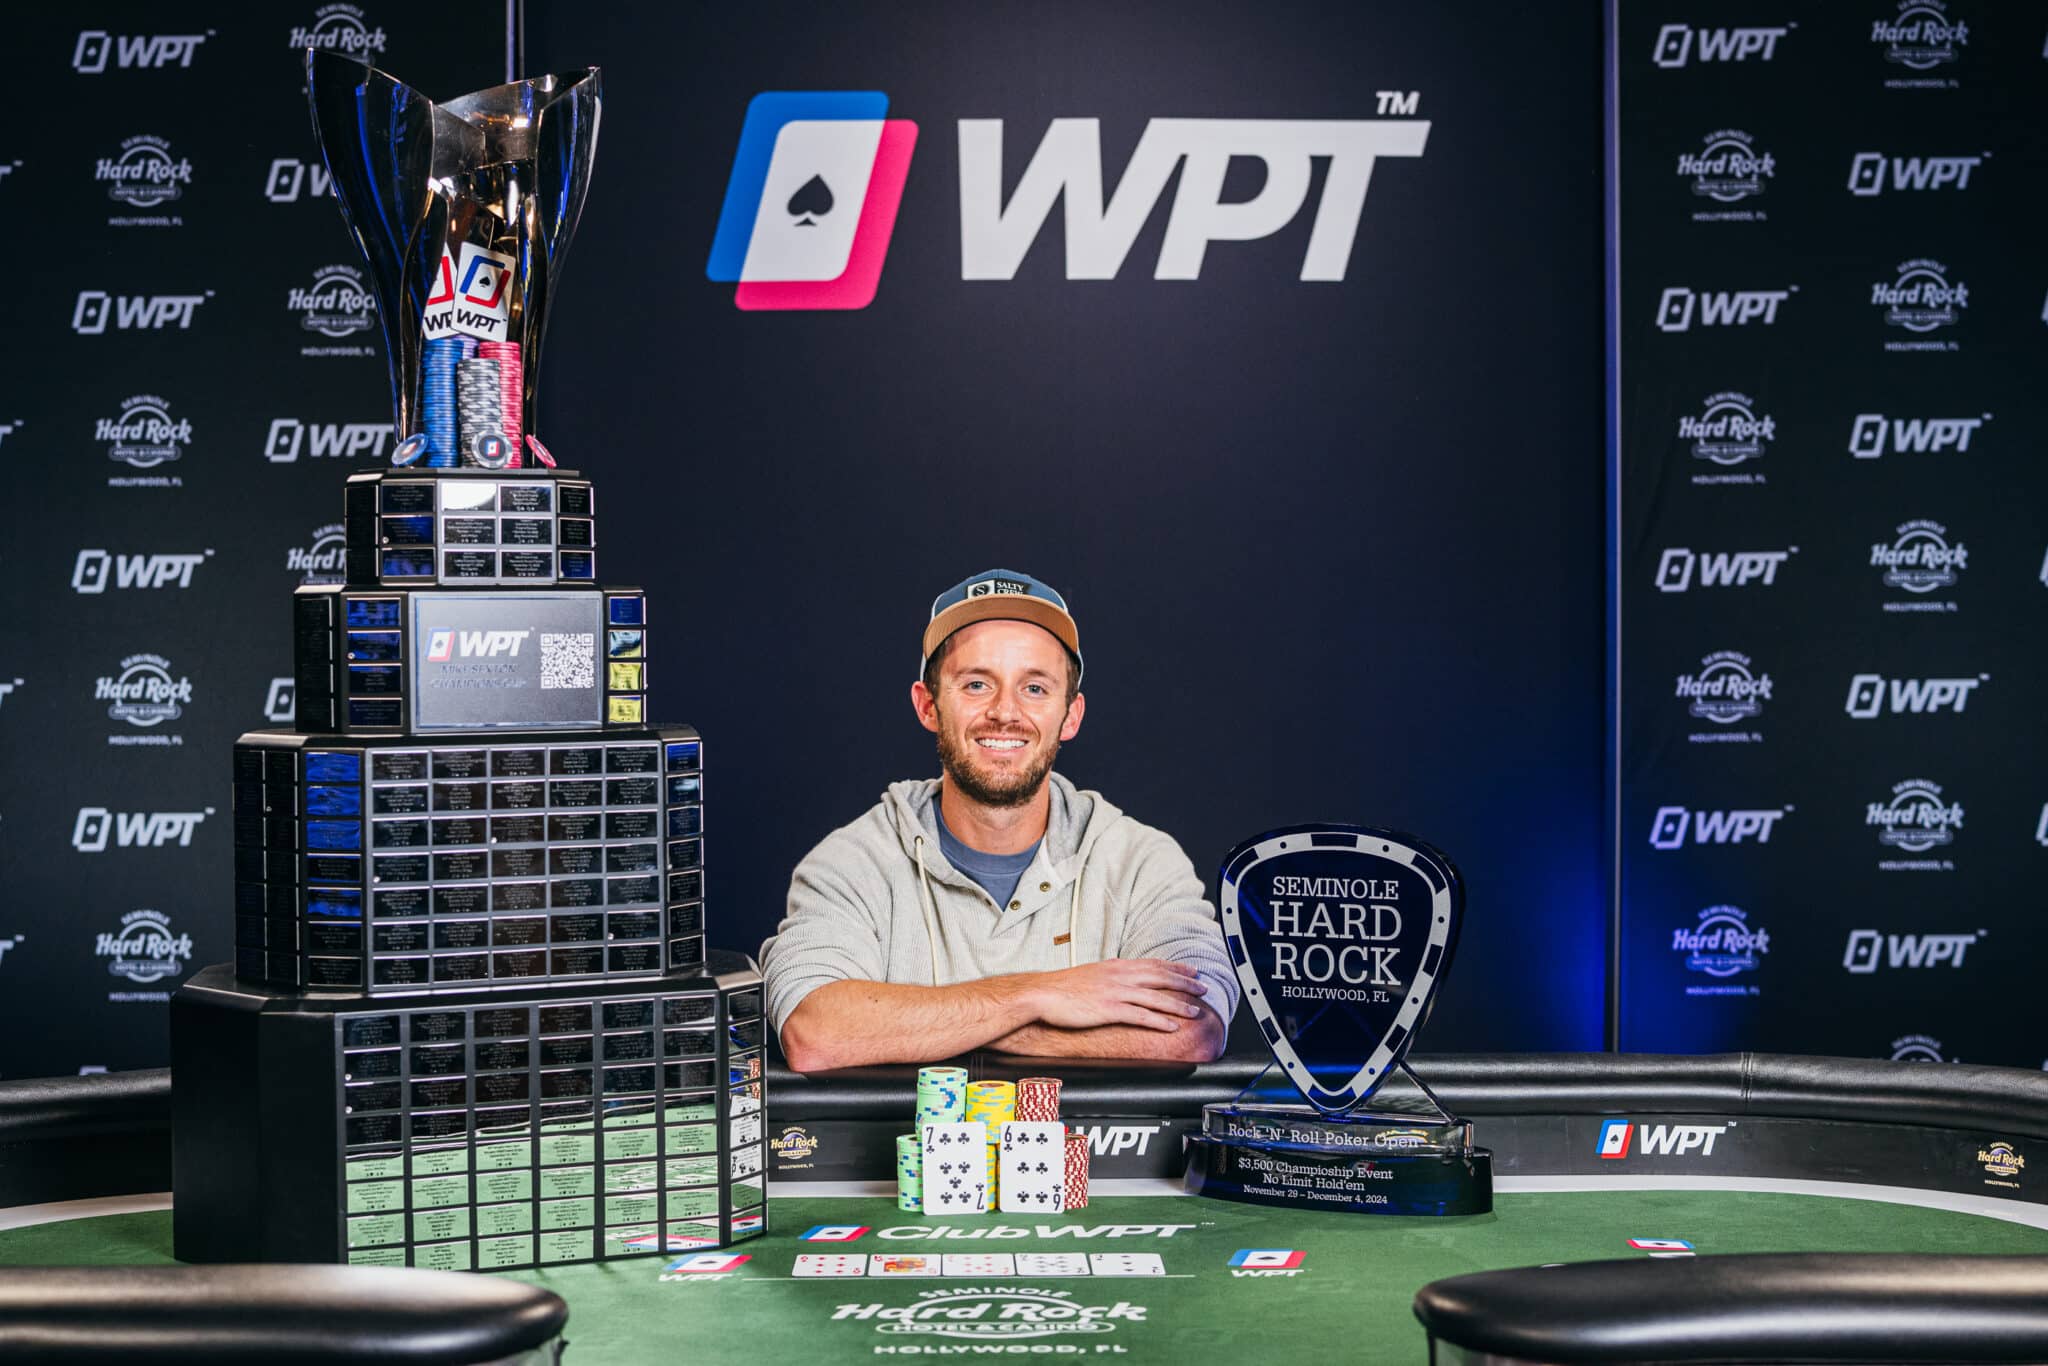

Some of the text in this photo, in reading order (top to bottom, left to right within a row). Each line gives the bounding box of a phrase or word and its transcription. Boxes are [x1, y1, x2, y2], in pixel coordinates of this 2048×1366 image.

[289, 27, 386, 53] Hard Rock
[1699, 27, 1787, 62] WPT
[1871, 20, 1968, 46] Hard Rock
[117, 35, 206, 68] WPT
[95, 158, 192, 184] Hard Rock
[1678, 153, 1775, 179] Hard Rock
[1893, 157, 1981, 190] WPT
[957, 90, 1432, 282] WPT TM
[287, 288, 376, 314] Hard Roc
[1871, 282, 1968, 308] Hard Rock
[117, 295, 205, 329] WPT
[456, 308, 500, 333] WPT
[1701, 291, 1789, 326] WPT
[95, 418, 192, 444] Hard Rock
[309, 423, 395, 457] WPT
[1678, 415, 1775, 441] Hard Rock
[1893, 418, 1982, 453] WPT
[287, 547, 337, 569] Hard
[1700, 551, 1788, 587] WPT
[1870, 543, 1967, 569] Hard Rock
[116, 554, 205, 588] WPT
[996, 581, 1024, 592] SALTY
[459, 630, 530, 657] WPT
[95, 677, 192, 703] Hard Rock
[1675, 674, 1772, 700] Hard Rock
[1890, 678, 1979, 713] WPT
[1695, 810, 1784, 844] WPT
[1866, 802, 1963, 828] Hard Rock
[116, 812, 205, 847] WPT
[1272, 875, 1399, 901] SEMINOLE
[1269, 900, 1402, 941] HARD
[95, 933, 192, 959] Hard Rock
[1672, 928, 1769, 954] Hard Rock
[1888, 934, 1977, 968] WPT
[1271, 942, 1402, 986] ROCK
[1282, 985, 1390, 1004] HOLLYWOOD, FL
[770, 1135, 818, 1149] Hard Rock
[925, 1127, 934, 1145] 7
[1004, 1125, 1013, 1143] 6
[1076, 1126, 1160, 1156] WPT
[1228, 1123, 1419, 1149] Rock 'N' Roll Poker Open
[1640, 1124, 1727, 1156] WPT
[1238, 1157, 1394, 1180] $3,500 Champioship Event
[1978, 1150, 2025, 1168] Hard Rock
[1243, 1184, 1286, 1198] November
[1307, 1191, 1352, 1203] December
[1354, 1195, 1364, 1205] 4,
[1365, 1195, 1388, 1205] 2024
[1262, 1173, 1365, 1191] No Limit Hold'em
[976, 1191, 984, 1210] 7
[876, 1225, 1197, 1240] ClubWPT
[1231, 1269, 1305, 1278] WPT
[918, 1287, 1072, 1299] SEMINOLE
[831, 1302, 1148, 1322] Hard Rock
[893, 1323, 968, 1332] HOTEL
[873, 1344, 1128, 1355] HOLLYWOOD, FL
